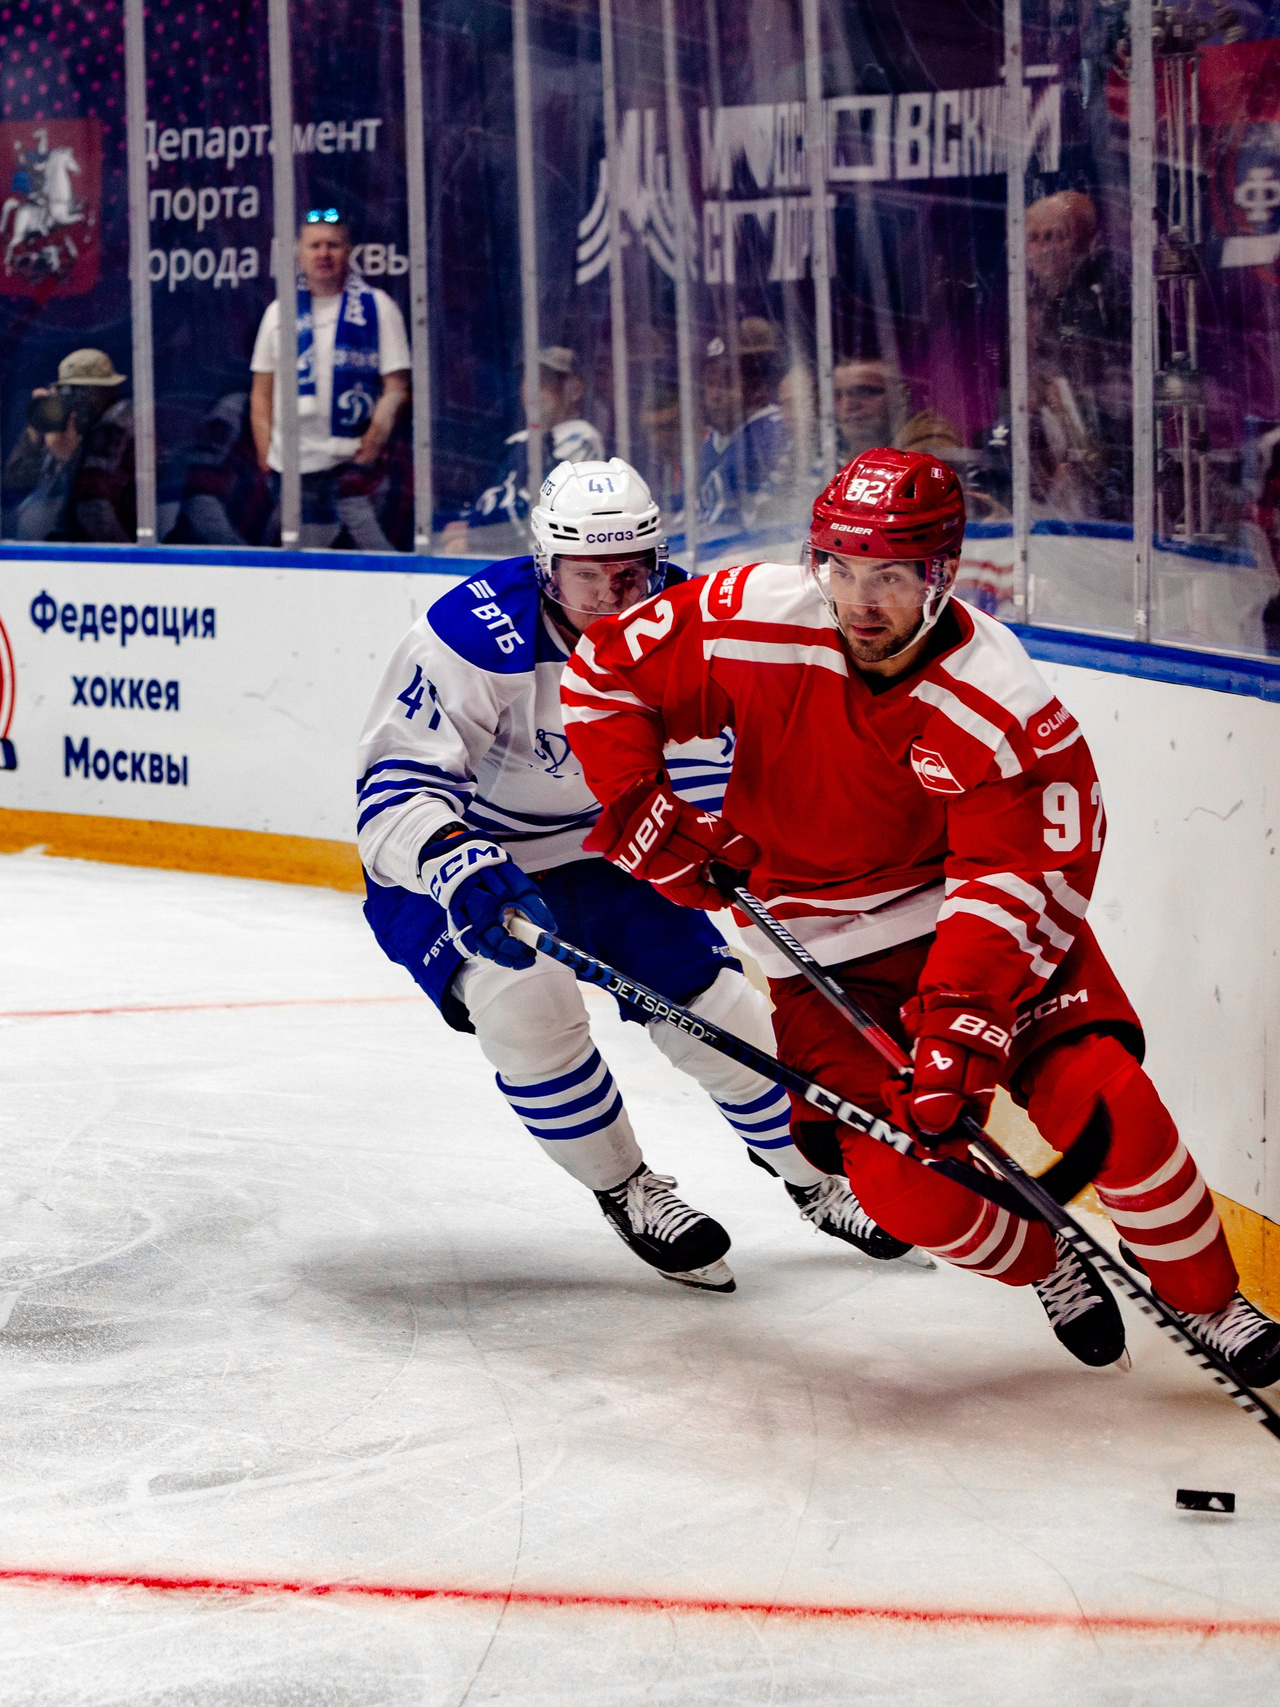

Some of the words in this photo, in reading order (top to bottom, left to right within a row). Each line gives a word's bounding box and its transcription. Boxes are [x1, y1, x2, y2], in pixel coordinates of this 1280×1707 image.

[143, 118, 382, 171] Департмент
[148, 184, 260, 233] порта
[147, 246, 260, 293] орода
[588, 477, 615, 493] 41
[845, 478, 887, 505] 92
[586, 531, 634, 543] согаз
[30, 589, 216, 647] Федерация
[471, 602, 526, 654] ВТБ
[72, 675, 181, 711] хоккея
[64, 735, 189, 786] Москвы
[429, 845, 500, 900] CCM
[606, 978, 706, 1040] JETSPEED
[1011, 988, 1089, 1038] CCM
[805, 1084, 916, 1155] CCM
